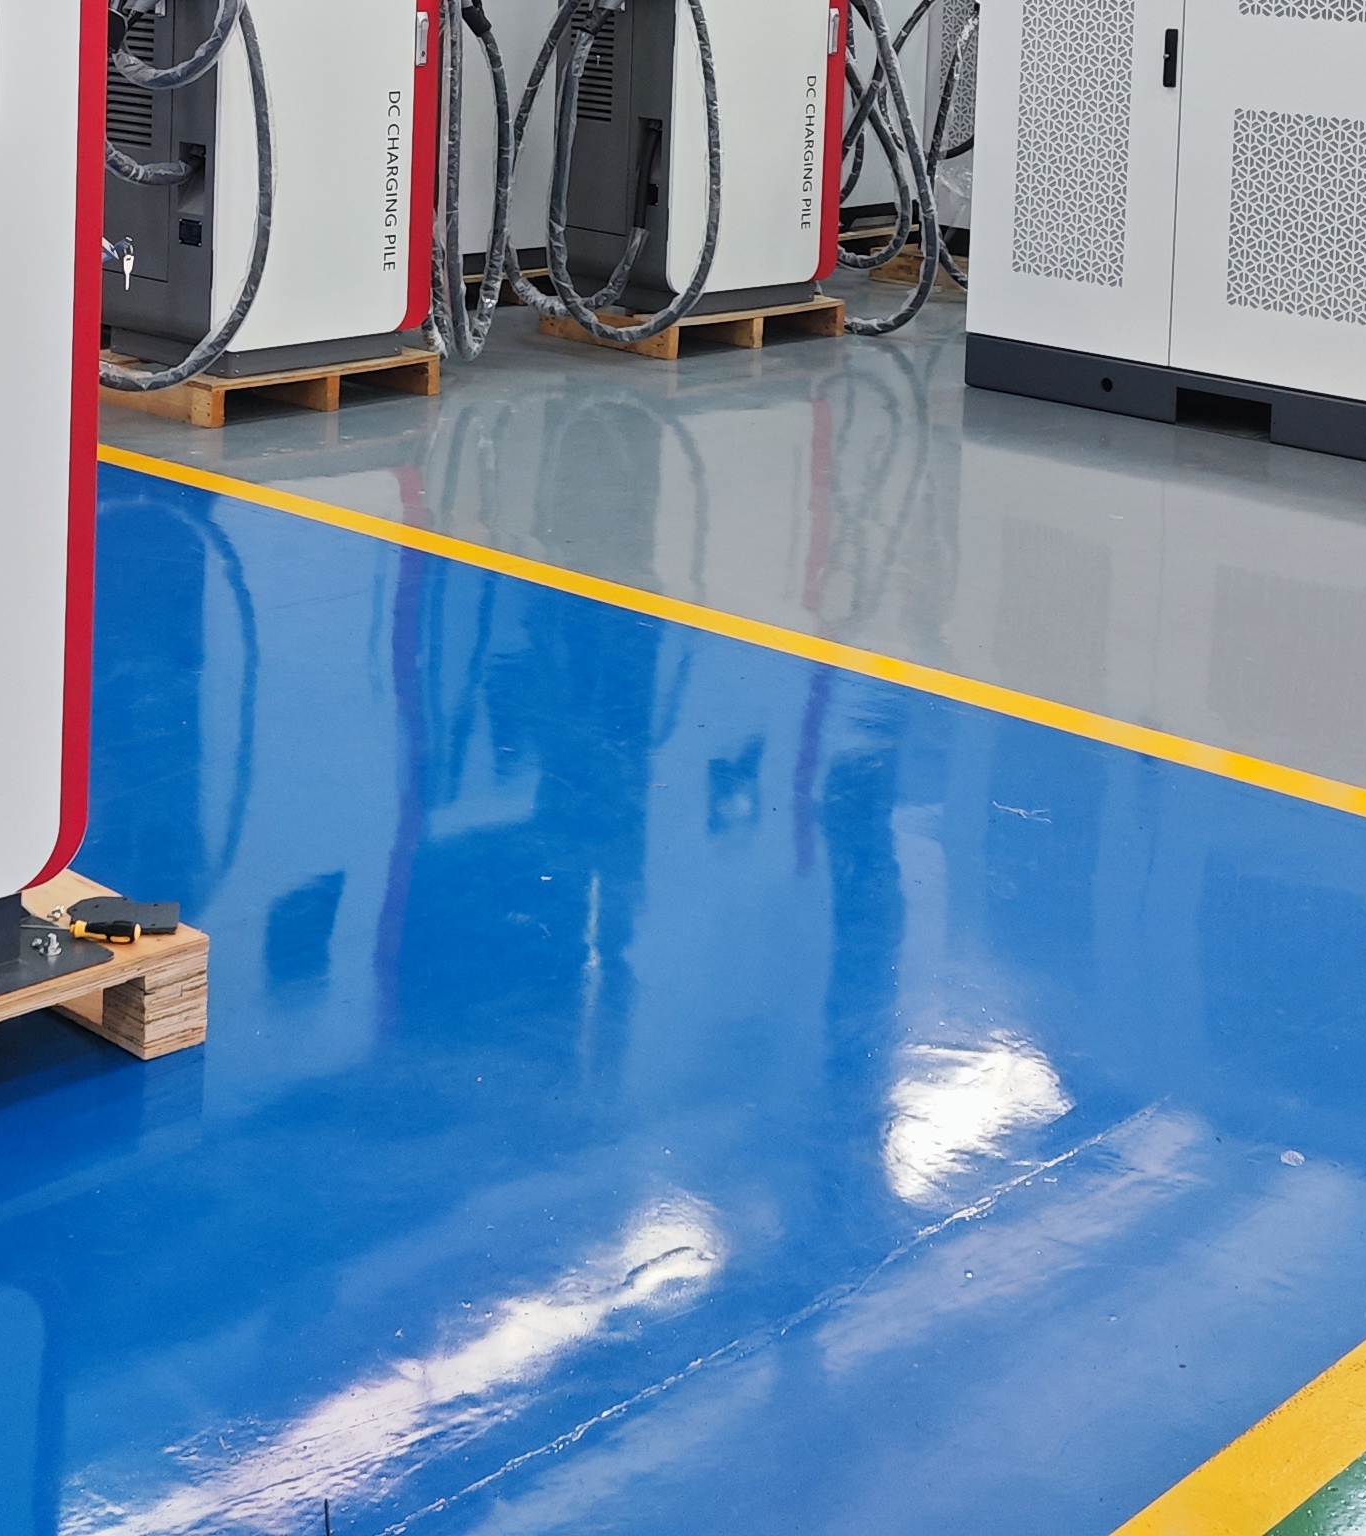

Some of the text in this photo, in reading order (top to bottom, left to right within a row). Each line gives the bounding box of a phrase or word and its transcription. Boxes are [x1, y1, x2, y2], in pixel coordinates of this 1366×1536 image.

[382, 90, 401, 272] DC CHARGING PILE
[800, 75, 817, 230] DC CHARGING PILE
